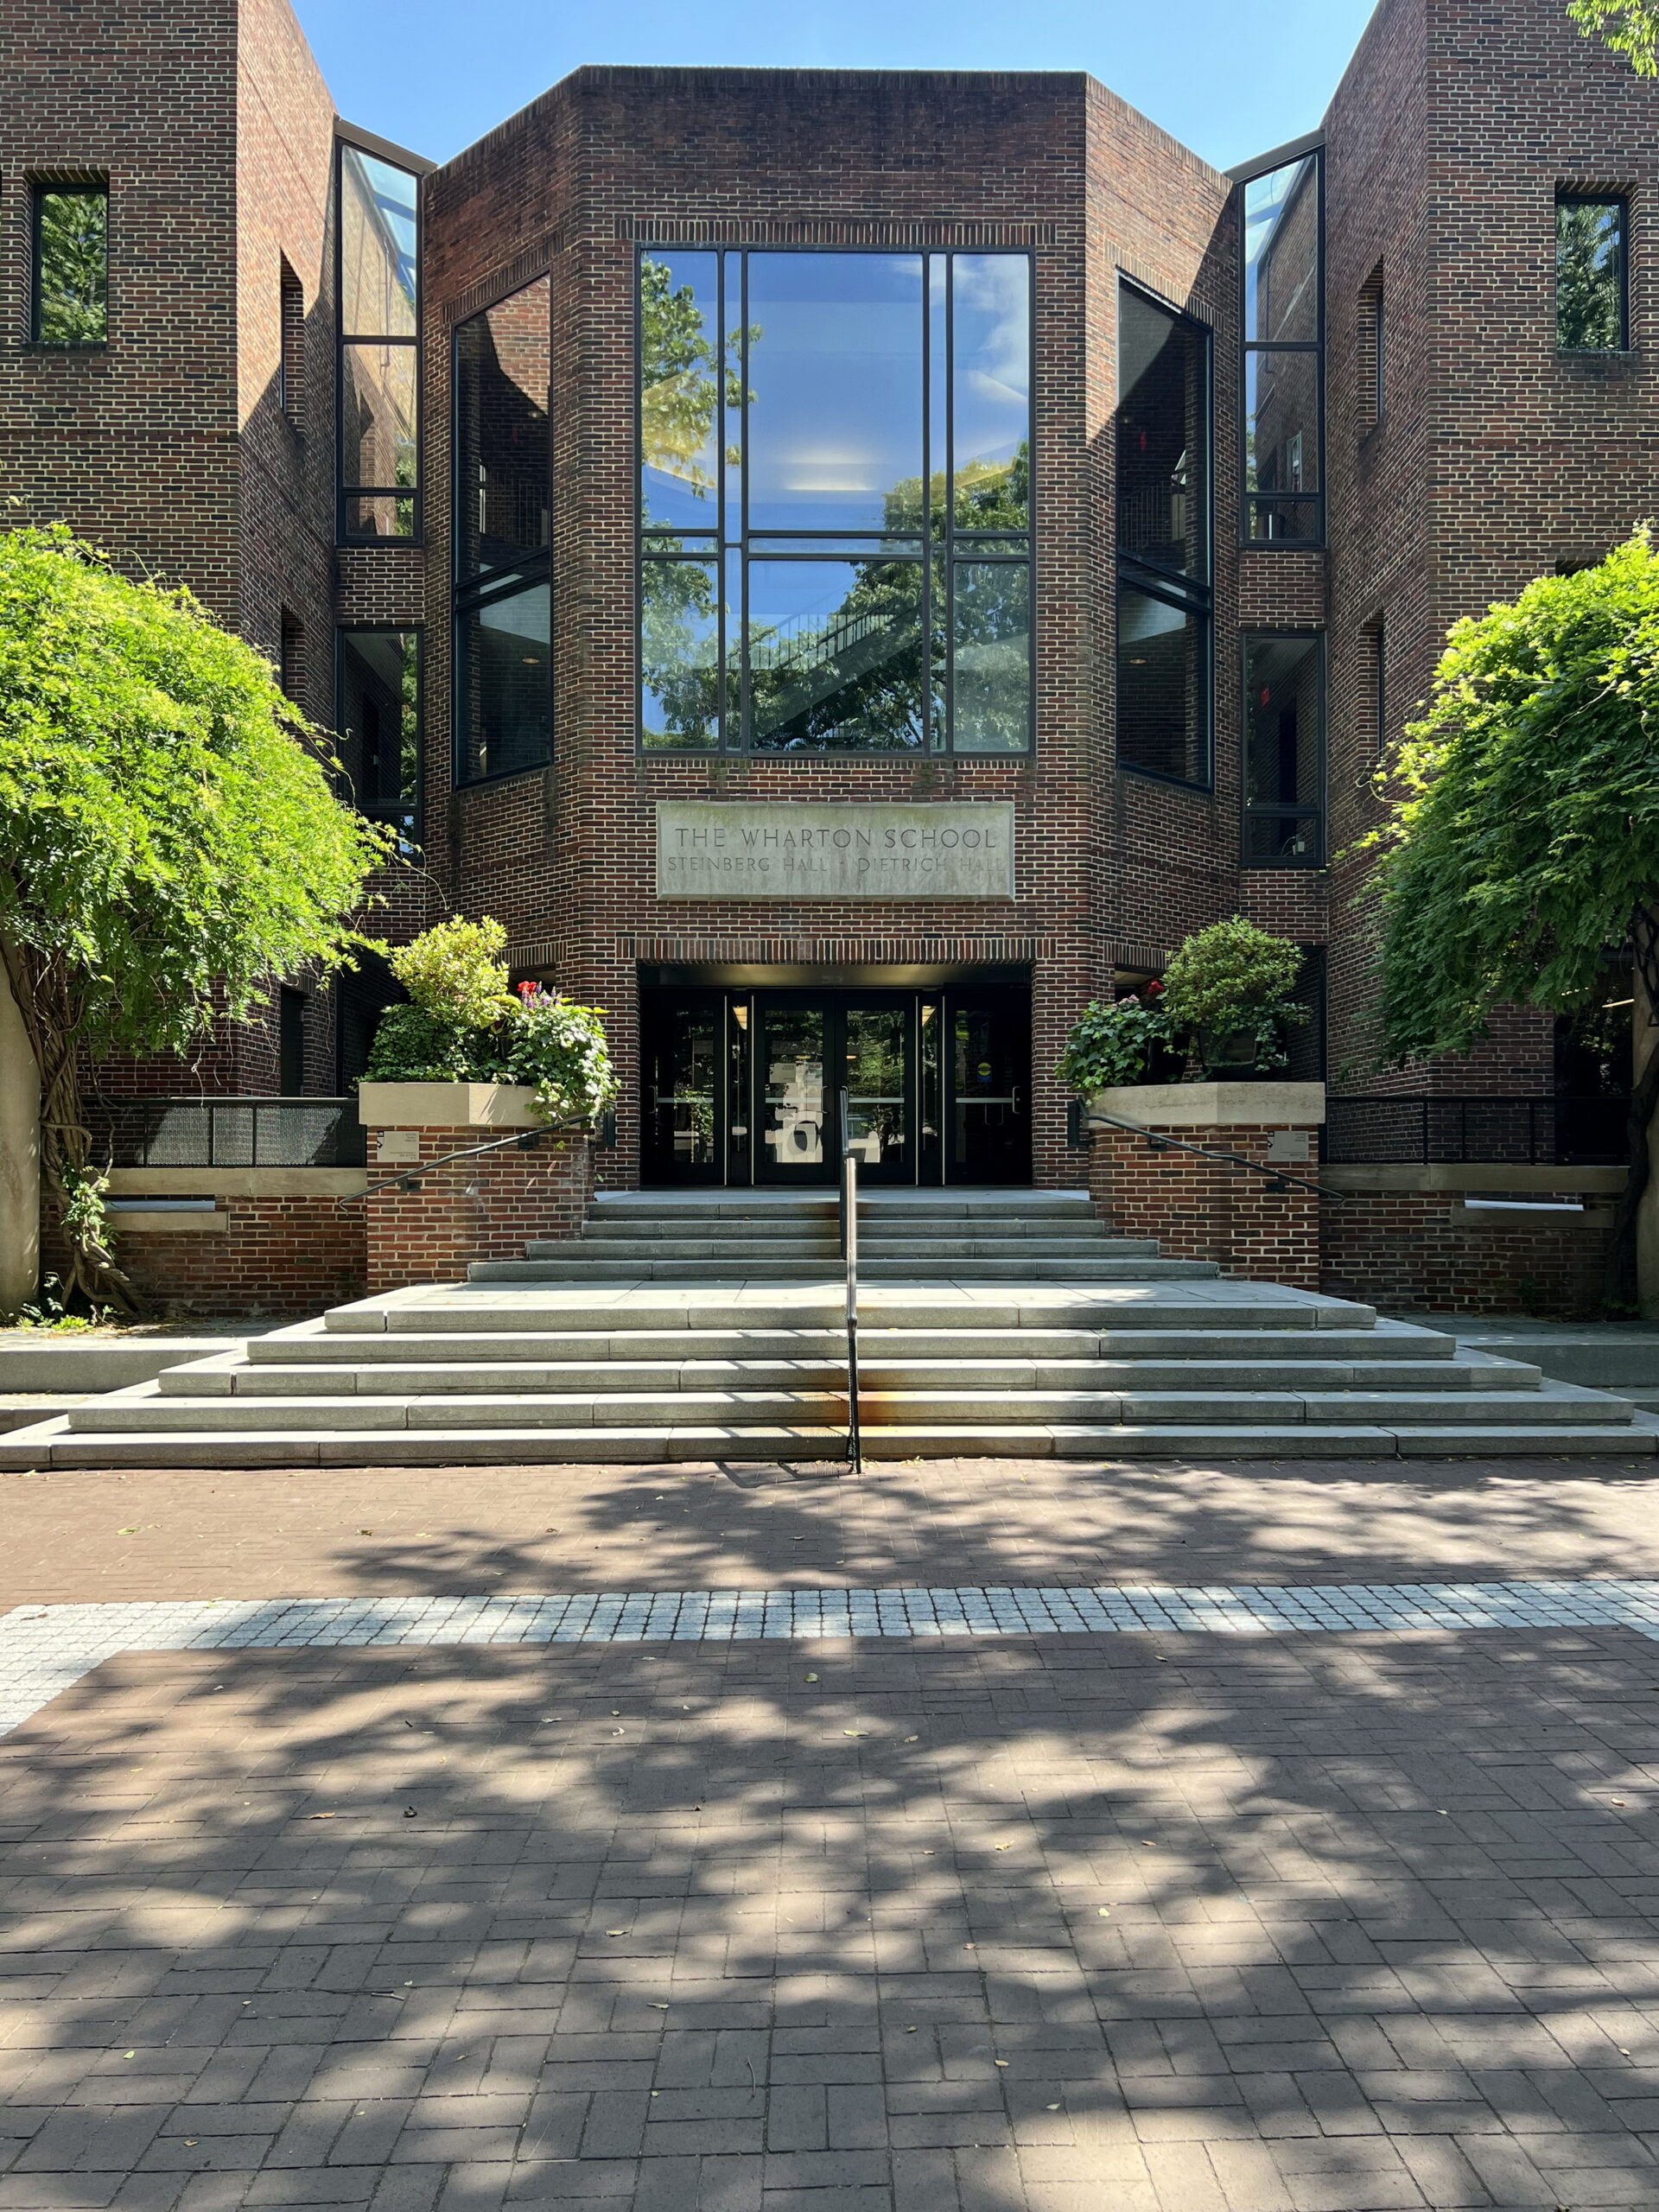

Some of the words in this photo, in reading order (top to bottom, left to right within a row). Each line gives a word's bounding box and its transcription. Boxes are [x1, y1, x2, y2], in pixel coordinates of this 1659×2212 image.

[675, 828, 726, 848] THE
[741, 828, 872, 849] WHARTON
[884, 829, 996, 849] SCHOOL
[668, 856, 770, 872] STEINBERG
[783, 857, 828, 872] HALL
[858, 857, 947, 872] DIETRICH
[959, 857, 1005, 872] HALL
